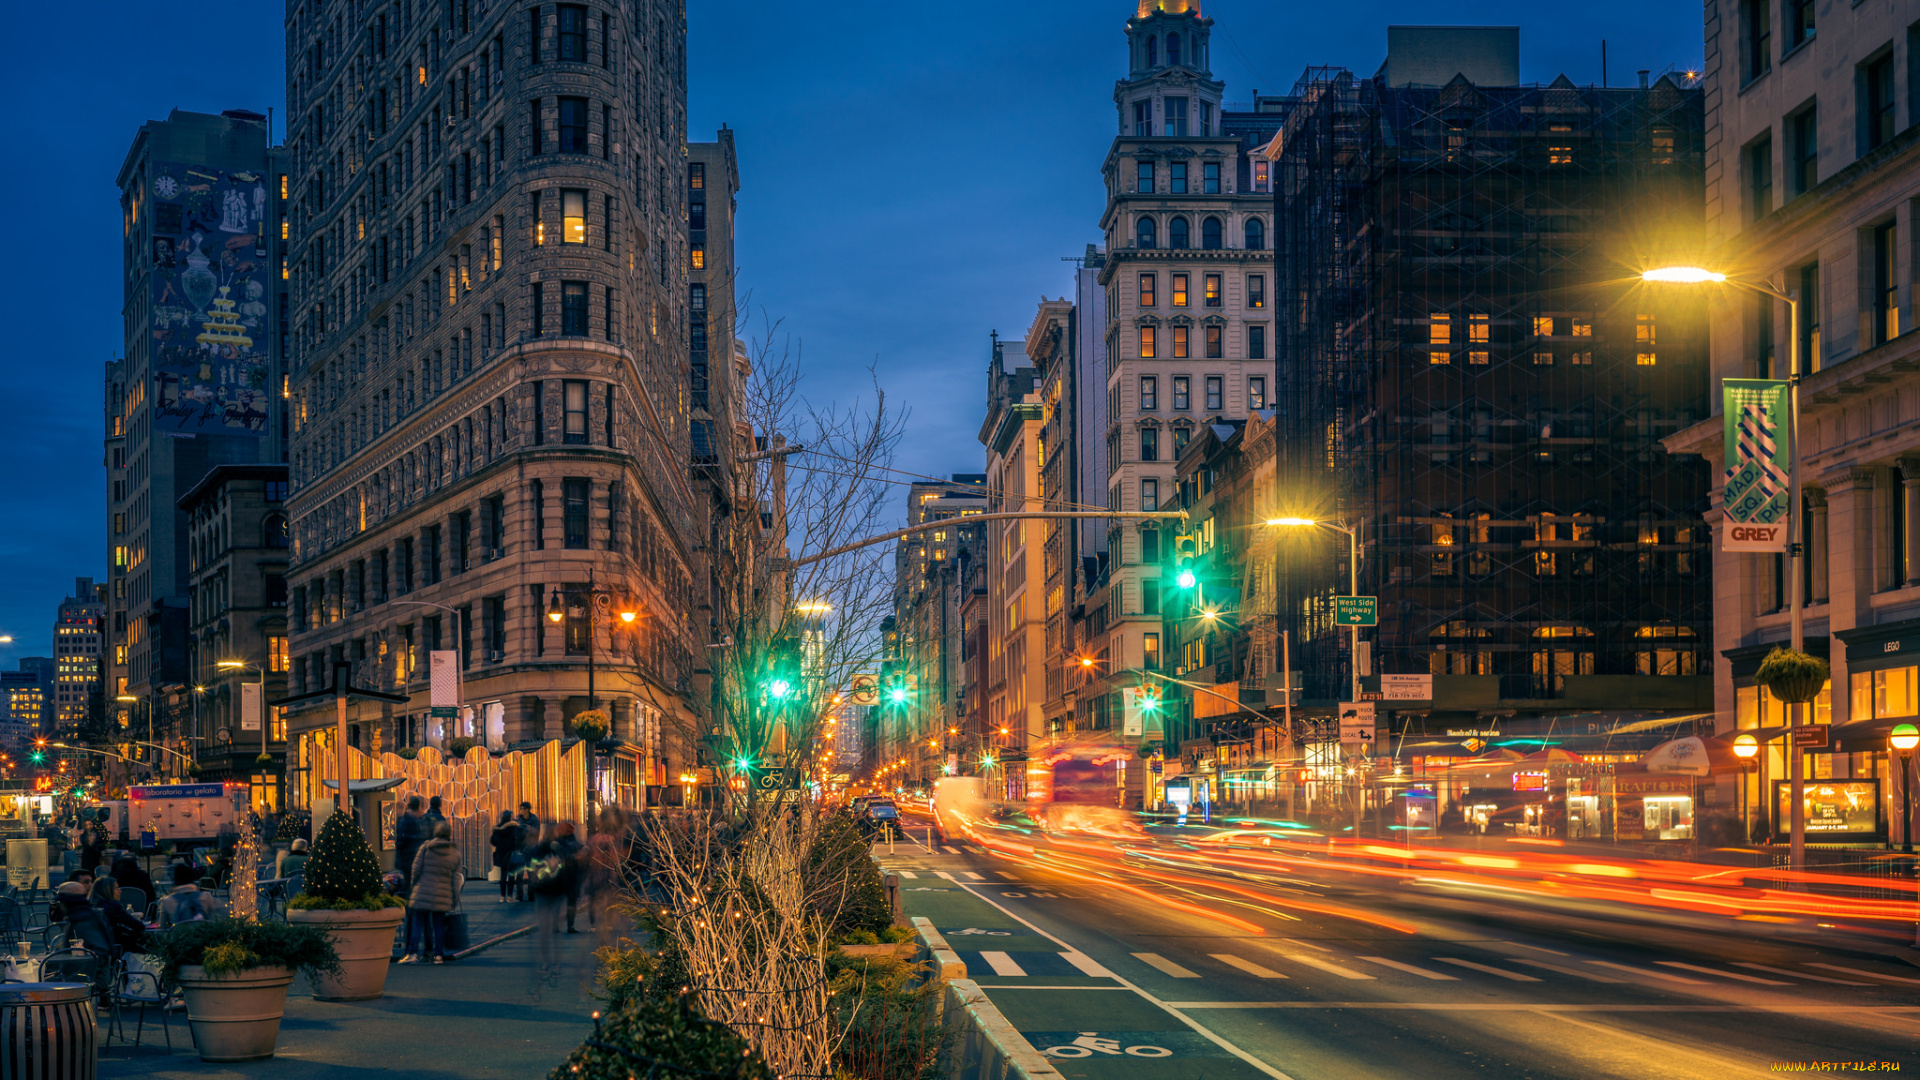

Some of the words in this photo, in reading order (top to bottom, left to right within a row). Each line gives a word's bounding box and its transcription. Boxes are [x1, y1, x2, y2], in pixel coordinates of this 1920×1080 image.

[1724, 470, 1759, 504] MAD.
[1735, 496, 1763, 519] SQ.
[1761, 499, 1786, 523] PK
[1731, 526, 1779, 541] GREY
[1341, 607, 1372, 615] Highway
[1884, 641, 1900, 653] LEGO
[145, 787, 182, 796] laboratorio
[194, 787, 217, 796] gelato
